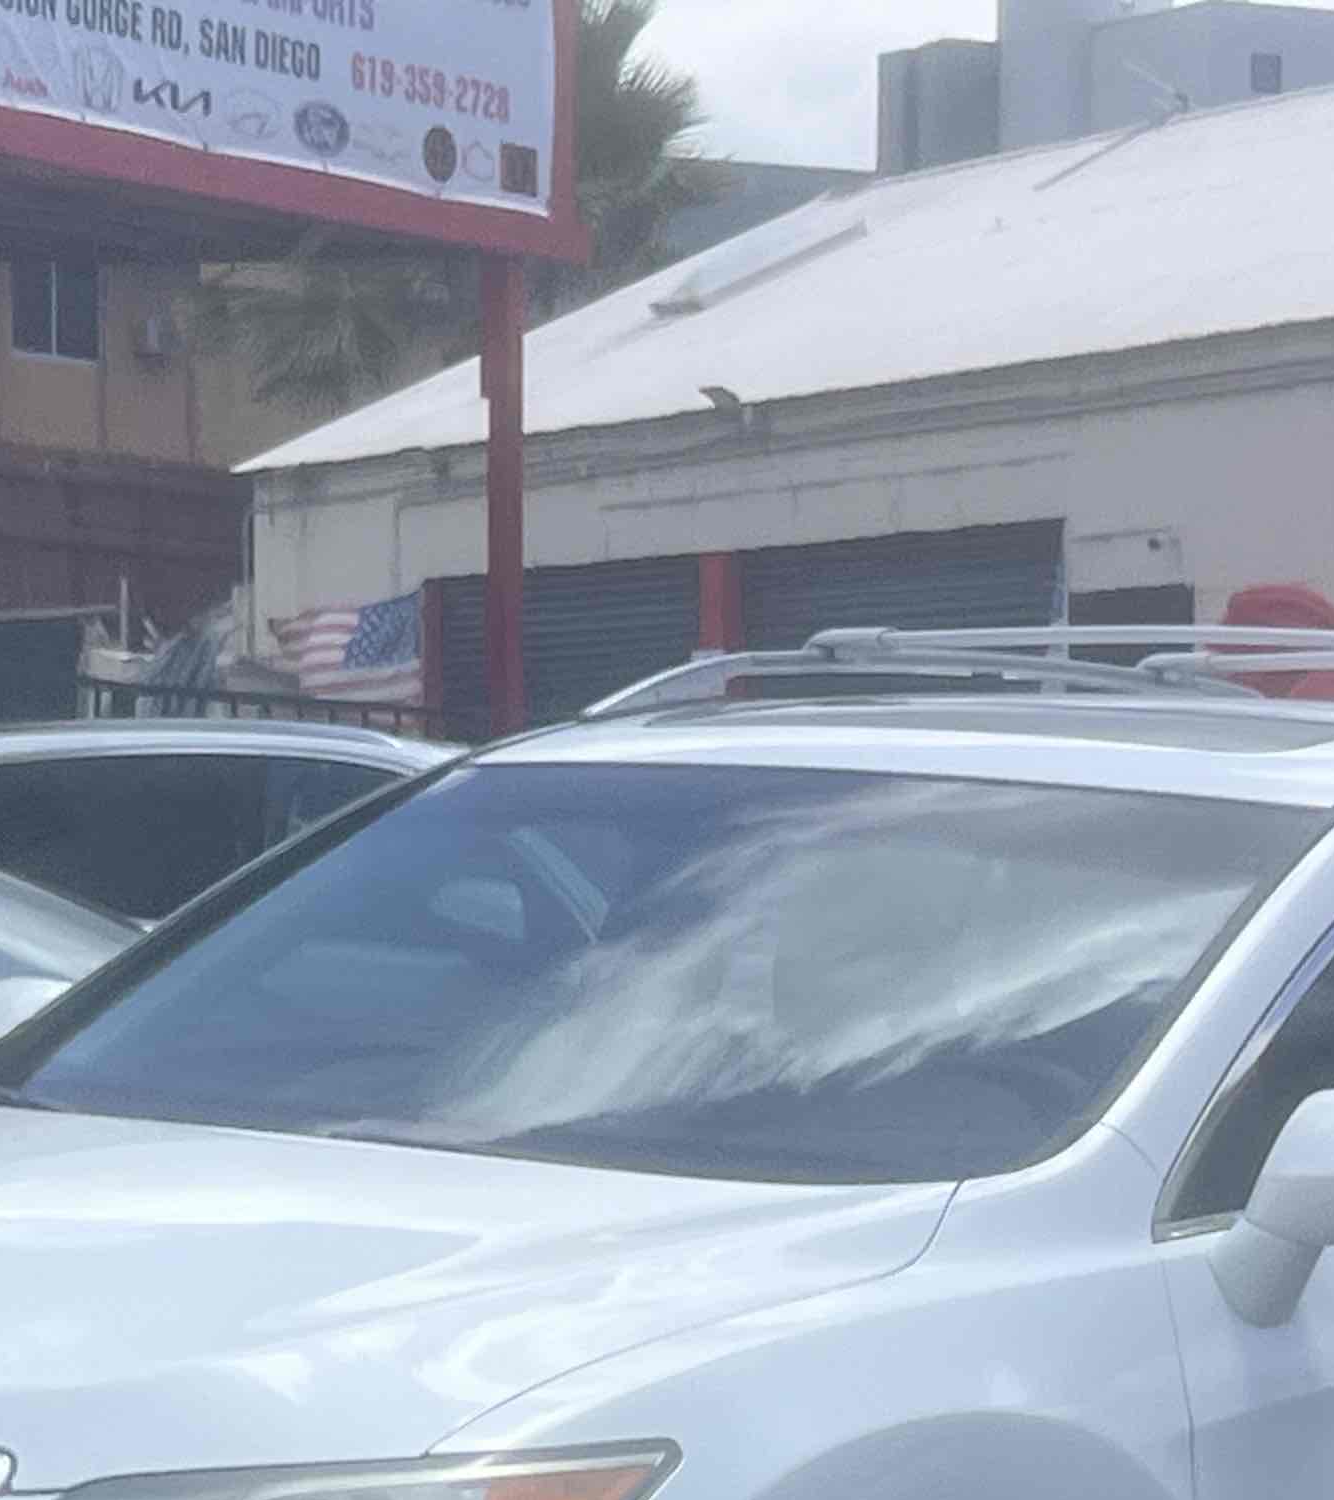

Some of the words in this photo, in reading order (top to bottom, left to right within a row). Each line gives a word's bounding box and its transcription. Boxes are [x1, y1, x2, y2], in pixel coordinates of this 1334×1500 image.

[151, 8, 188, 56] RD,
[199, 19, 246, 65] SAN
[255, 29, 320, 80] DIEGO
